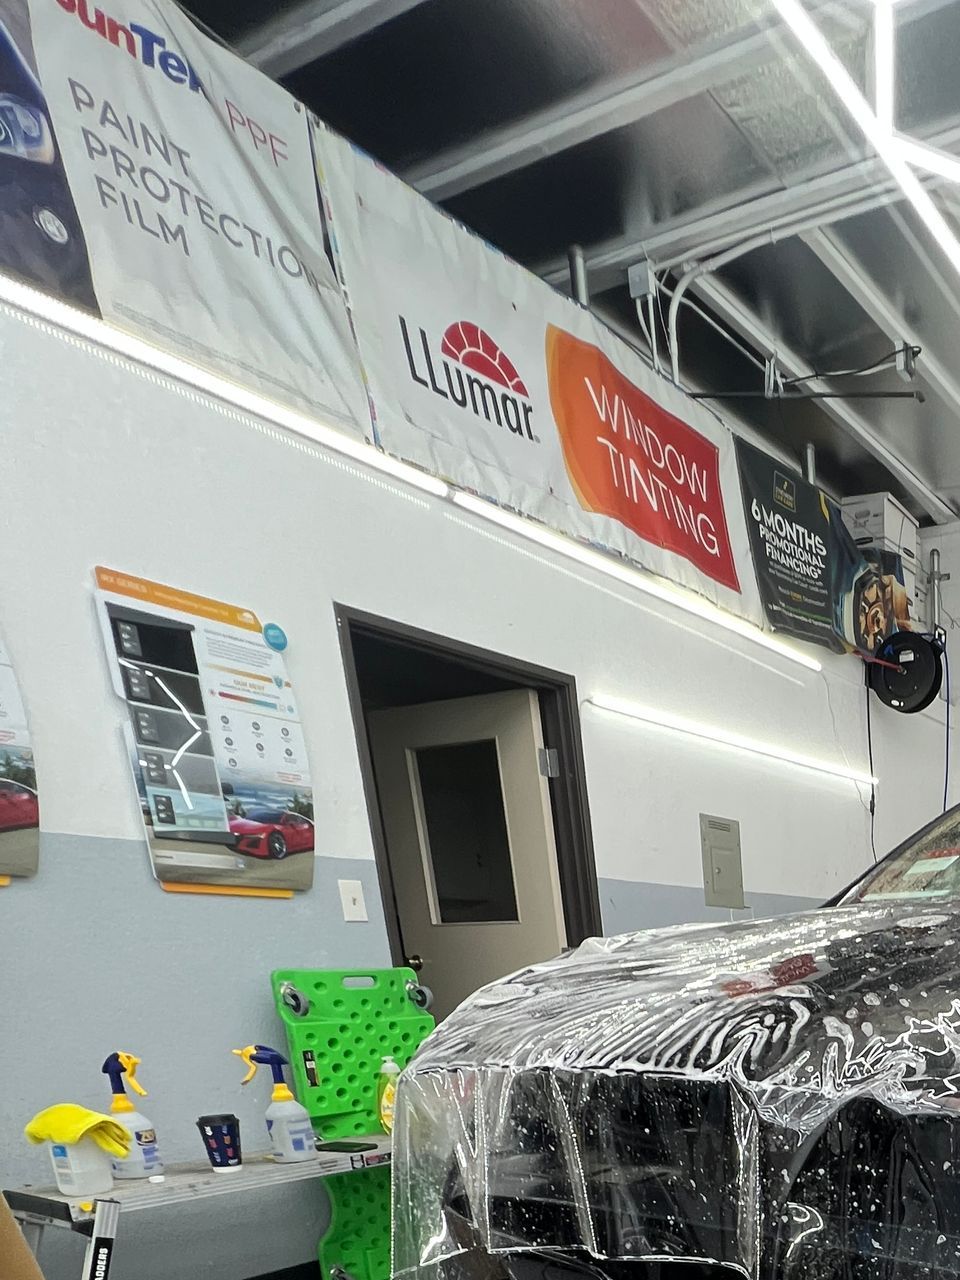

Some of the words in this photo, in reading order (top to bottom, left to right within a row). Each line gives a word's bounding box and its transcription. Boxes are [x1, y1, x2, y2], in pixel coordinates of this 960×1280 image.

[56, 0, 200, 93] unTe
[68, 77, 190, 177] PAINT
[225, 99, 288, 167] PPF
[94, 174, 190, 257] FILM
[398, 314, 535, 442] LLumar
[584, 376, 707, 502] WINDOW
[596, 435, 721, 557] TINTING
[751, 498, 761, 522] 6
[761, 503, 827, 556] MONTHS
[759, 523, 826, 568] PROMOTIONAL
